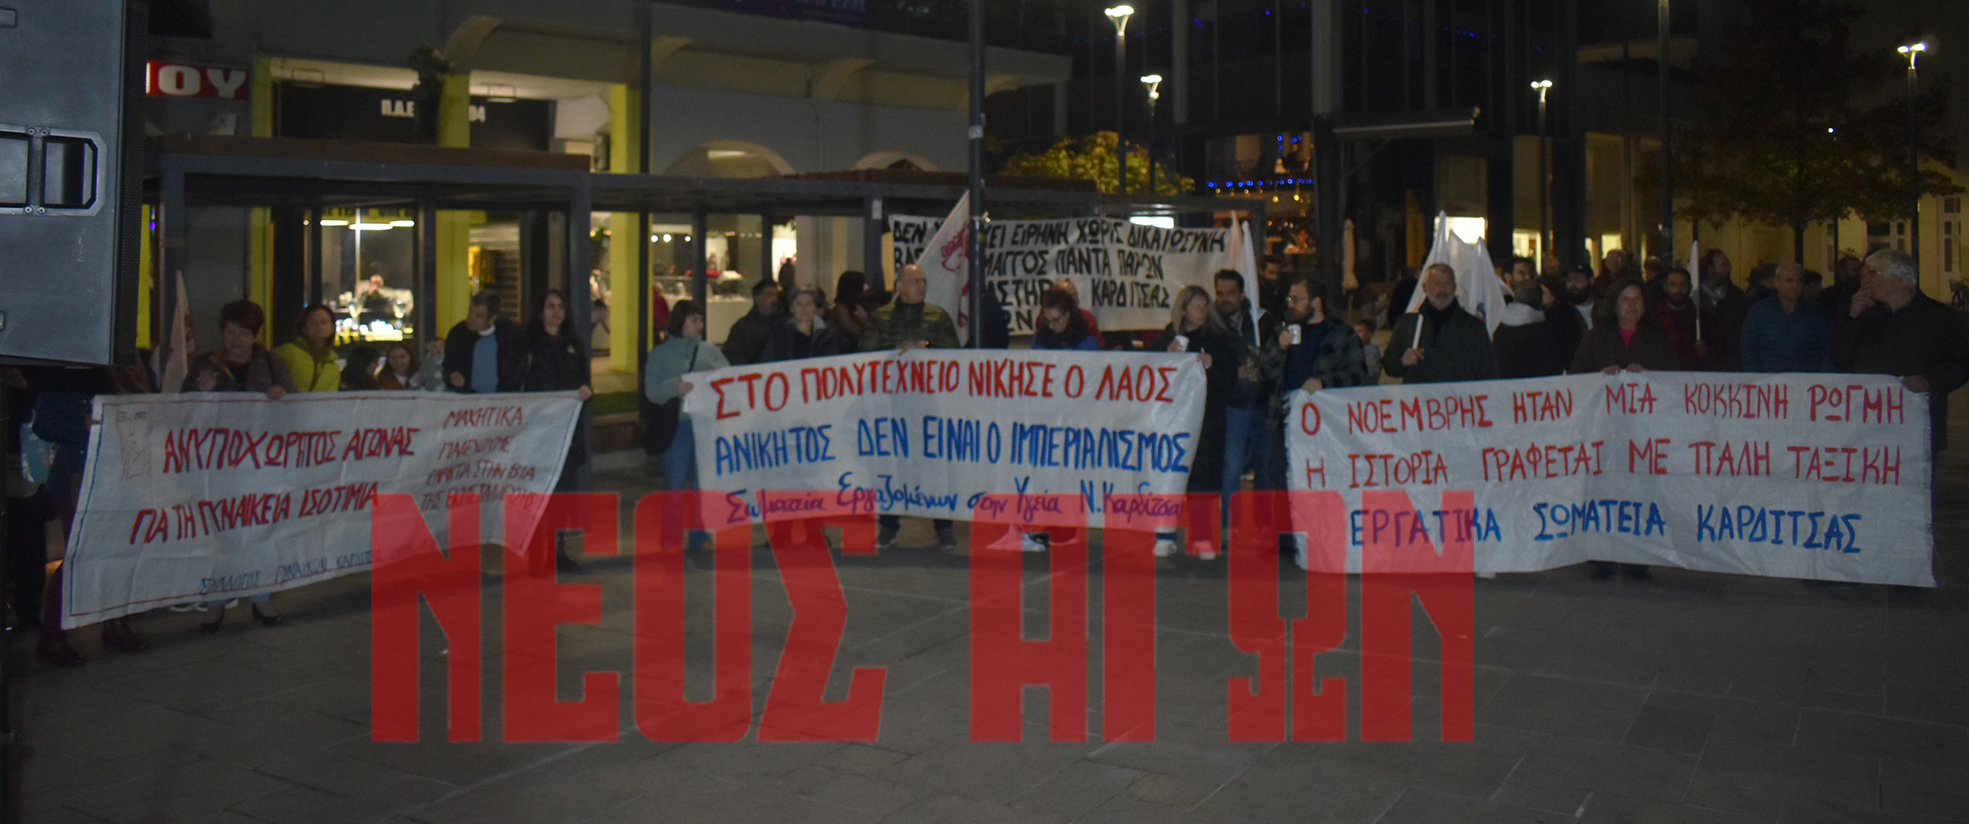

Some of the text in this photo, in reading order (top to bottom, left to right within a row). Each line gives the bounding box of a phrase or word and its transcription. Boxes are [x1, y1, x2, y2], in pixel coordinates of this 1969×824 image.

[145, 62, 247, 99] ΟΥ
[893, 221, 927, 243] ΔΕΝ
[1012, 221, 1069, 246] ΕΙΡΗΝΗ
[1077, 219, 1123, 245] ΧΩΡΙΣ
[1127, 226, 1226, 252] ΔΙΚΑΙΟΣΥΝΗ
[1056, 248, 1112, 275] ΠΑΝΤΑ
[1117, 249, 1164, 280] ΠΑΡΩΝ
[1091, 278, 1170, 308] ΚΑΡΔΙΤΣΑΣ
[710, 358, 1178, 420] ΣΤΟ ΠΟΛΥΤΕΧΝΕΙΟ ΝΙΚΗΣΕ Ο ΛΑΟΣ
[1301, 382, 1904, 435] Ο ΝΟΕΜΒΡΗΣ ΗΤΑΝ ΜΙΑ ΚΟΚΚΙΝΗ ΡΩΓΜΗ
[443, 406, 523, 430] ΜΑΧΗΤΙΚΑ
[343, 426, 420, 462] ΑΓΩΝΑΣ
[715, 415, 1191, 476] ΑΝΙΚΗΤΟΣ ΔΕΝ ΕΙΝΑΙ Ο ΙΜΠΕΡΙΑΛΙΣΜΟΣ
[1306, 438, 1901, 489] Η ΙΣΤΟΡΙΑ ΓΡΑΦΕΤΑΙ ΜΕ ΠΑΛΗ ΤΑΞΙΚΗ
[130, 481, 378, 545] ΓΙΑ ΤΗ ΓΥΝΑΙΚΕΙΑ ΙΣΟΤΙΜΙΑ
[1014, 475, 1063, 523] Υγεία
[1351, 500, 1862, 553] ΕΡΓΑΤΙΚΑ ΣΩΜΑΤΕΙΑ ΚΑΡΔΙΤΣΑΣ
